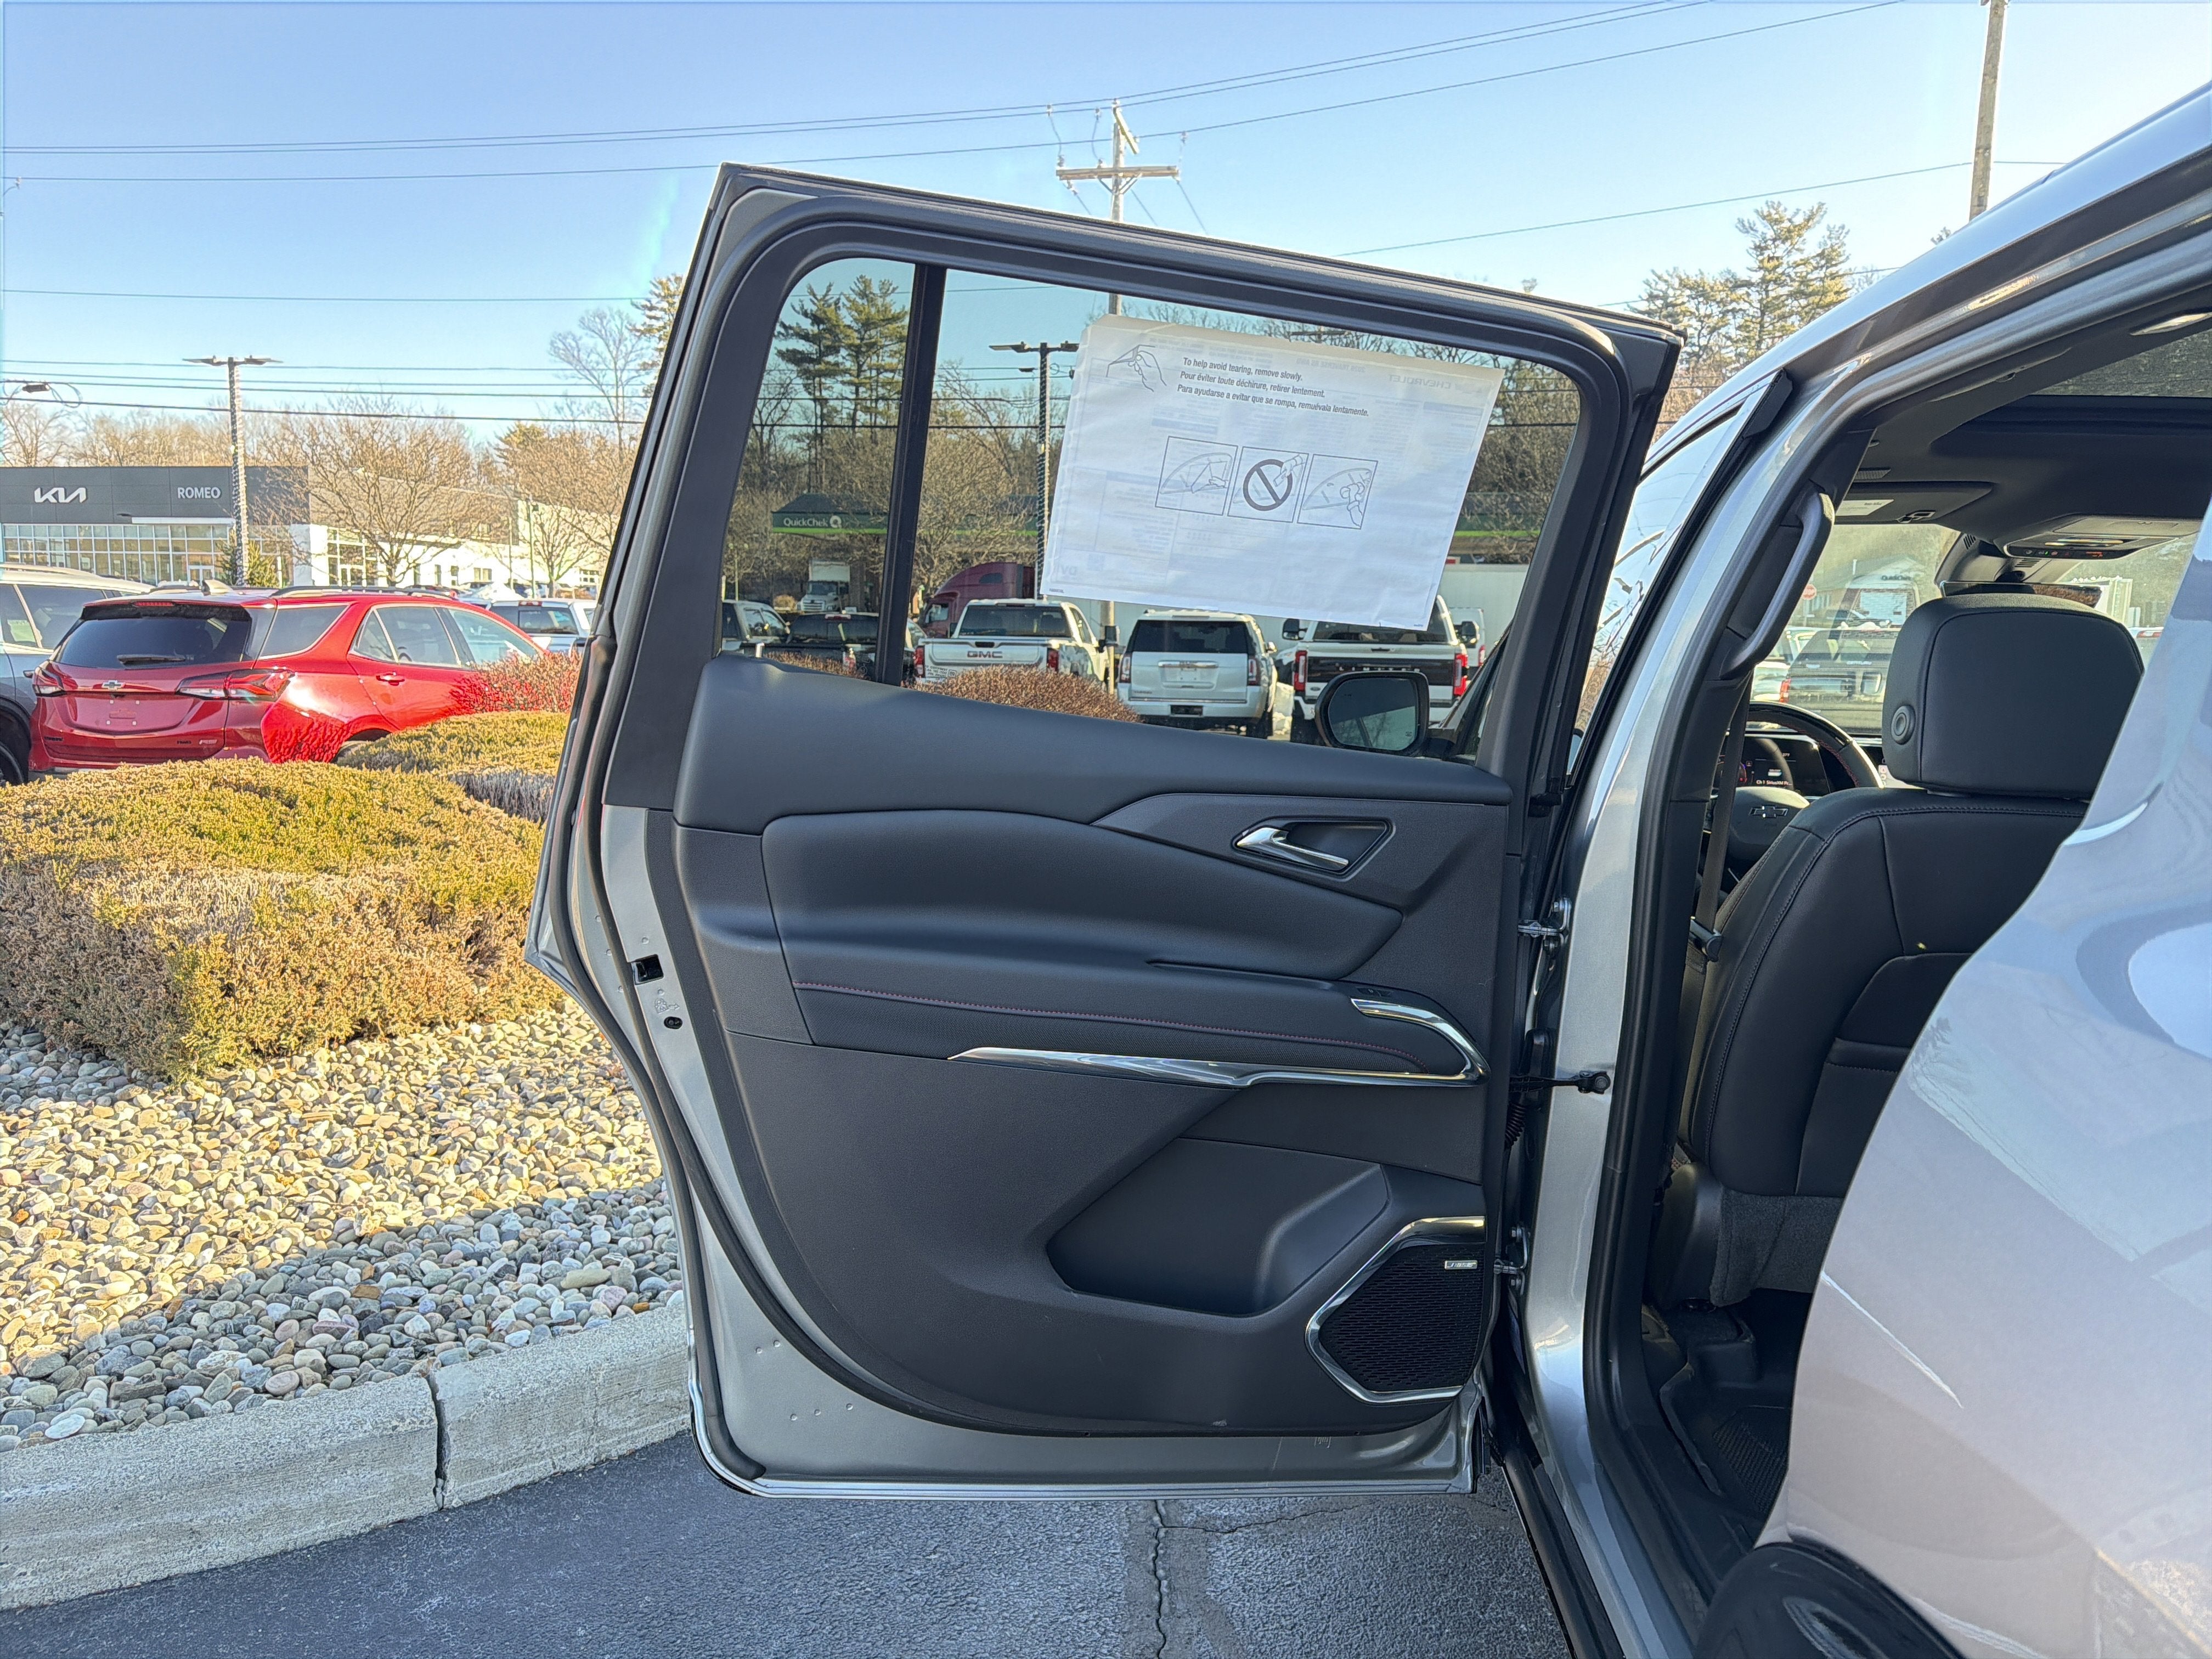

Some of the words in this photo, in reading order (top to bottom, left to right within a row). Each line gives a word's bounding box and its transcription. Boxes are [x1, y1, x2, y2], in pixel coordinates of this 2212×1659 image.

[1183, 357, 1192, 366] To
[1193, 359, 1207, 369] help
[1209, 362, 1227, 371] avoid
[1228, 364, 1253, 375] tearing,
[1255, 368, 1279, 377] remove
[1280, 370, 1302, 382] slowly.
[1180, 371, 1196, 380] Pour
[1197, 373, 1216, 383] éviter
[1218, 376, 1234, 386] toute
[1236, 379, 1268, 391] déchirure,
[1269, 384, 1290, 393] retirer
[1291, 386, 1325, 398] lentement.
[1177, 384, 1193, 393] Para
[1194, 387, 1225, 398] ayudarse
[1232, 393, 1251, 402] evitar
[1251, 396, 1264, 404] que
[1274, 398, 1296, 409] rompa,
[1298, 402, 1331, 412] remuévala
[1333, 405, 1369, 416] lentamente.
[177, 487, 221, 499] ROMEO
[783, 517, 828, 527] QuickChek
[967, 651, 1003, 659] GMC
